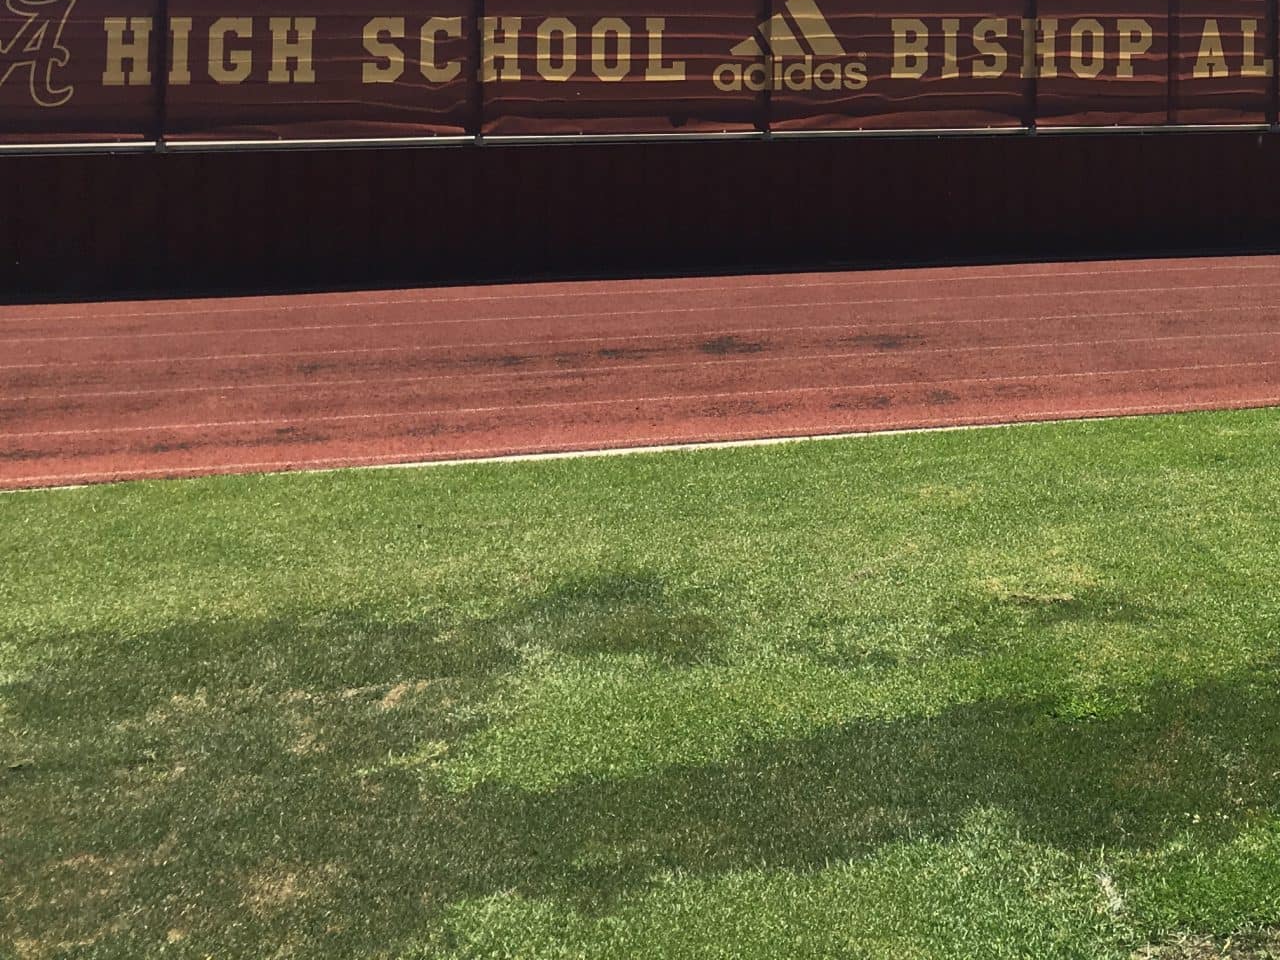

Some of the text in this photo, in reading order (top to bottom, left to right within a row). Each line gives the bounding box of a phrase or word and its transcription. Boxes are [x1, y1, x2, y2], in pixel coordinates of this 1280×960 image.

[103, 16, 686, 85] HIGH SCHOOL
[713, 55, 868, 91] adidas
[890, 18, 1153, 79] BISHOP
